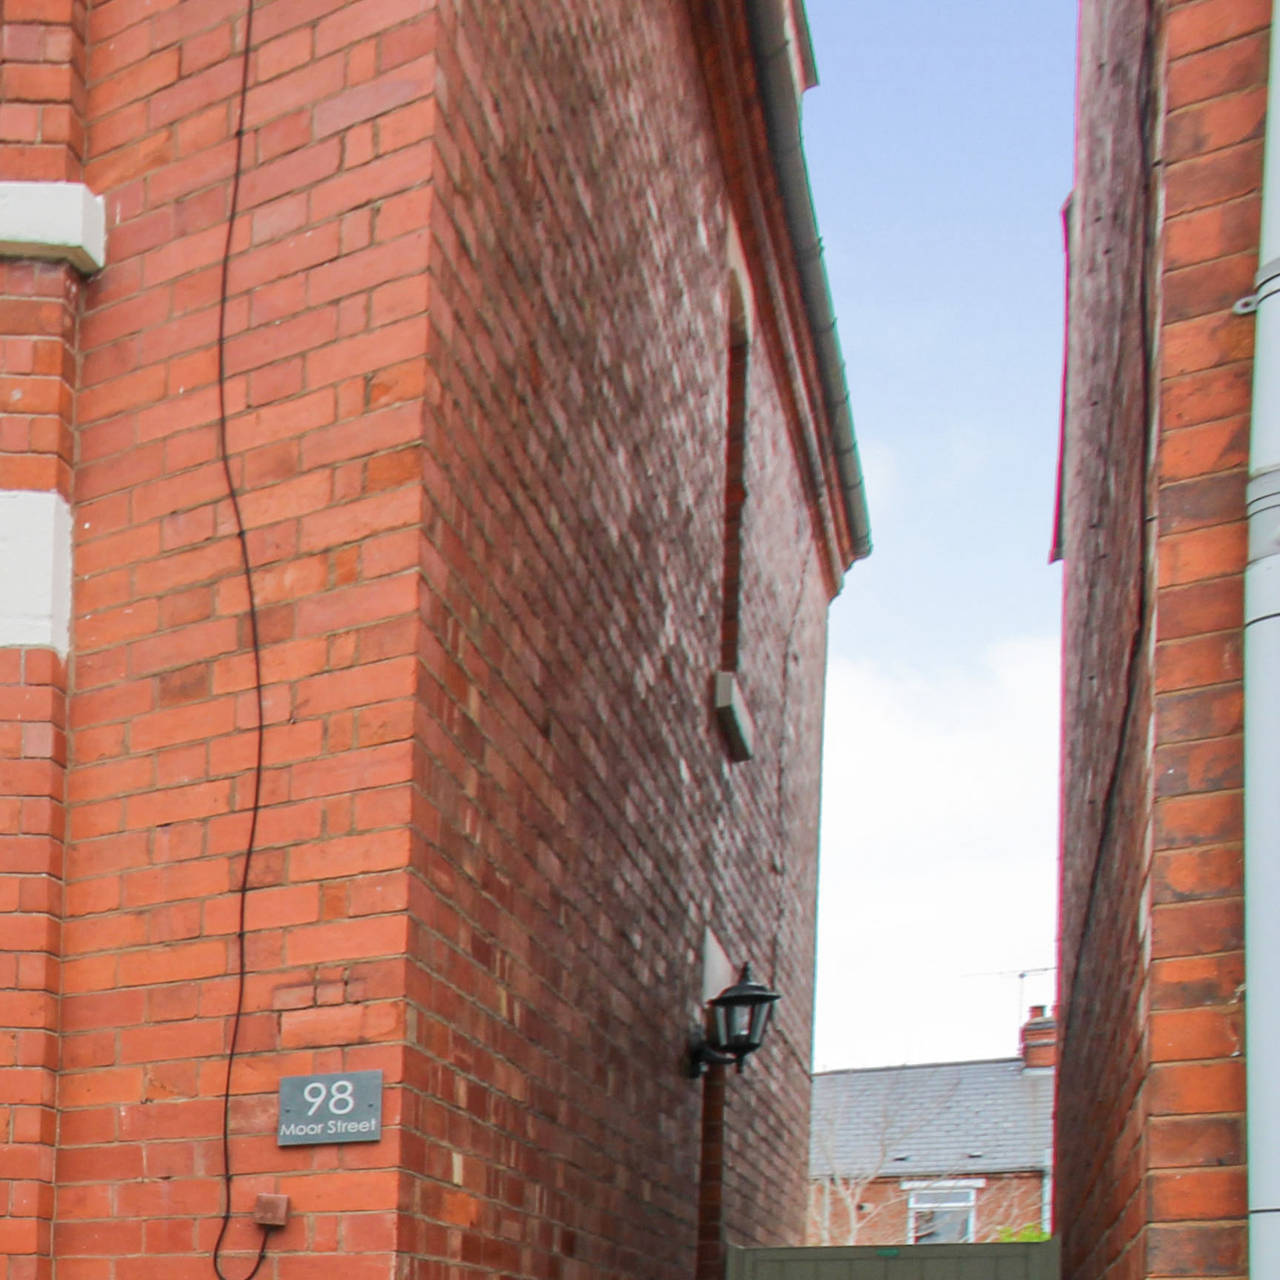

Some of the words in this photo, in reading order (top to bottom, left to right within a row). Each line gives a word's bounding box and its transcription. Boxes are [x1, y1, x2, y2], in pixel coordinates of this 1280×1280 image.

[303, 1080, 354, 1116] 98
[280, 1123, 324, 1136] Moor
[327, 1117, 377, 1134] Street
